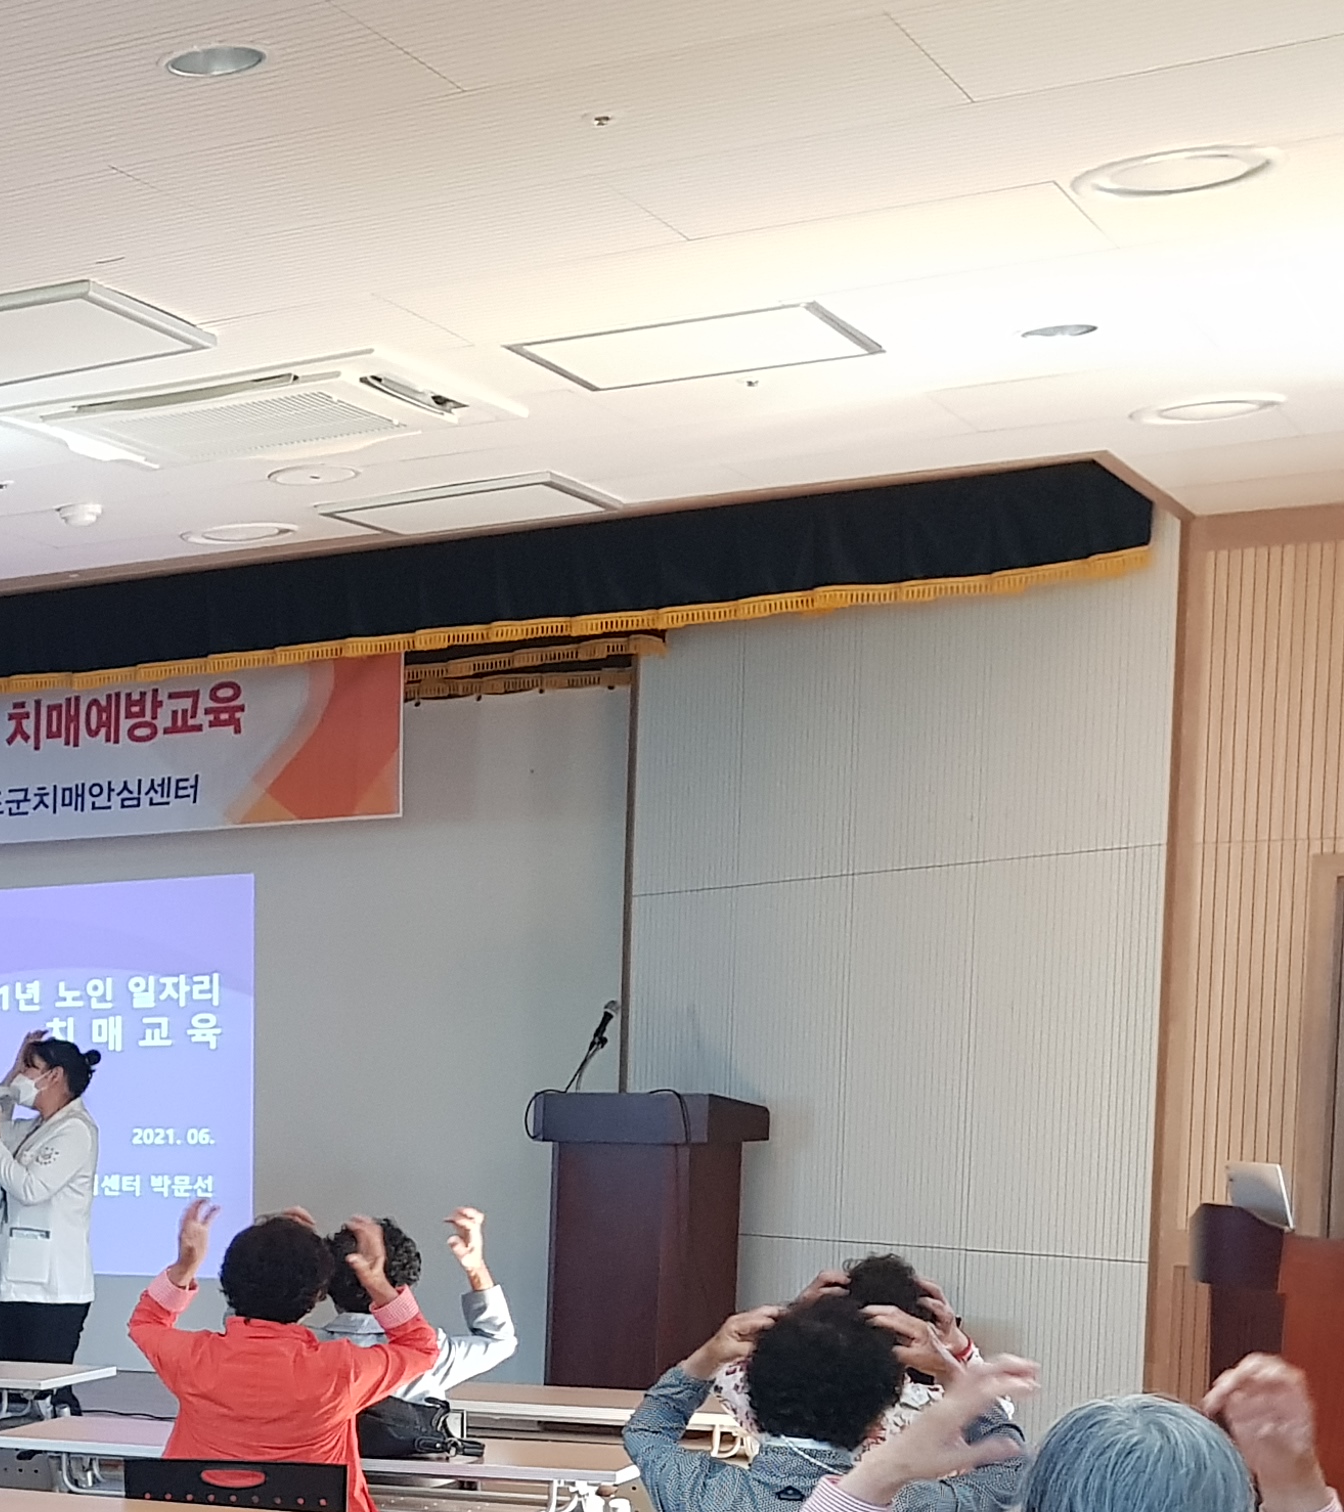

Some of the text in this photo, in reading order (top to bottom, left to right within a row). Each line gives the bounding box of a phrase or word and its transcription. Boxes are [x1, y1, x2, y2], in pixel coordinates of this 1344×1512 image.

[5, 680, 246, 752] 치매예방교육
[54, 977, 114, 1010] 노인
[127, 972, 220, 1009] 일자리
[132, 1127, 216, 1145] 2021. 06.
[150, 1172, 214, 1198] 박문선
